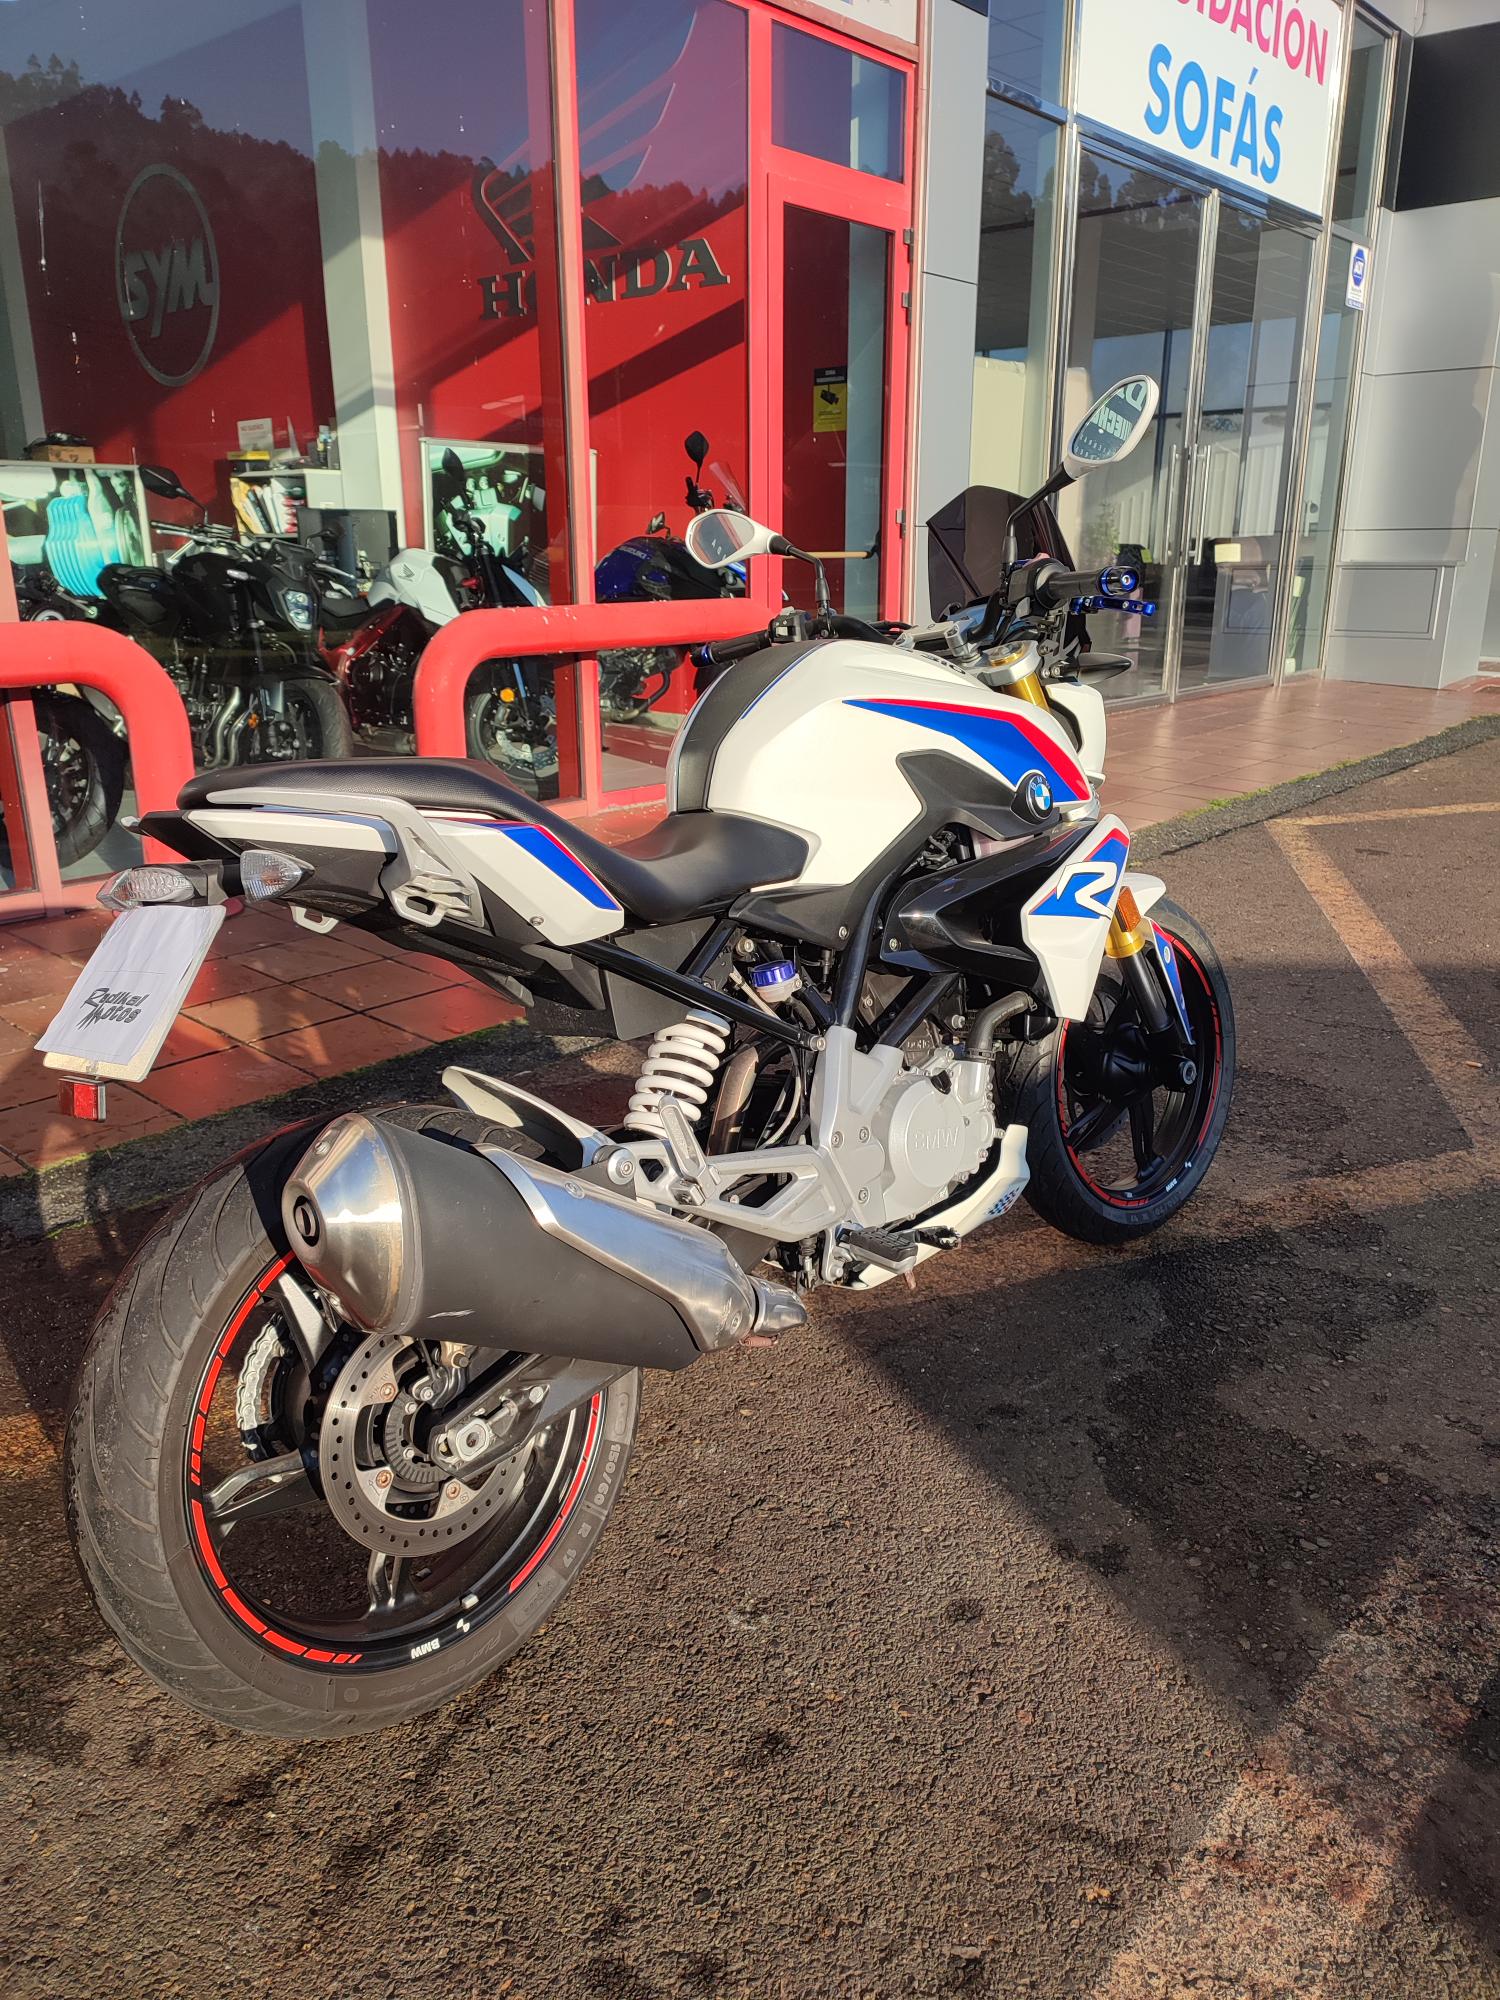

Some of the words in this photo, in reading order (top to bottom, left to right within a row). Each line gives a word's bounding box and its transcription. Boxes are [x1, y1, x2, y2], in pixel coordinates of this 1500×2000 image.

[1144, 43, 1284, 184] SOFÁS
[122, 236, 218, 338] SYM
[1056, 861, 1118, 921] R
[914, 1126, 960, 1151] BMW
[596, 1443, 621, 1506] 150/60
[577, 1522, 592, 1539] R
[562, 1548, 577, 1568] 17
[410, 1637, 441, 1660] BMW
